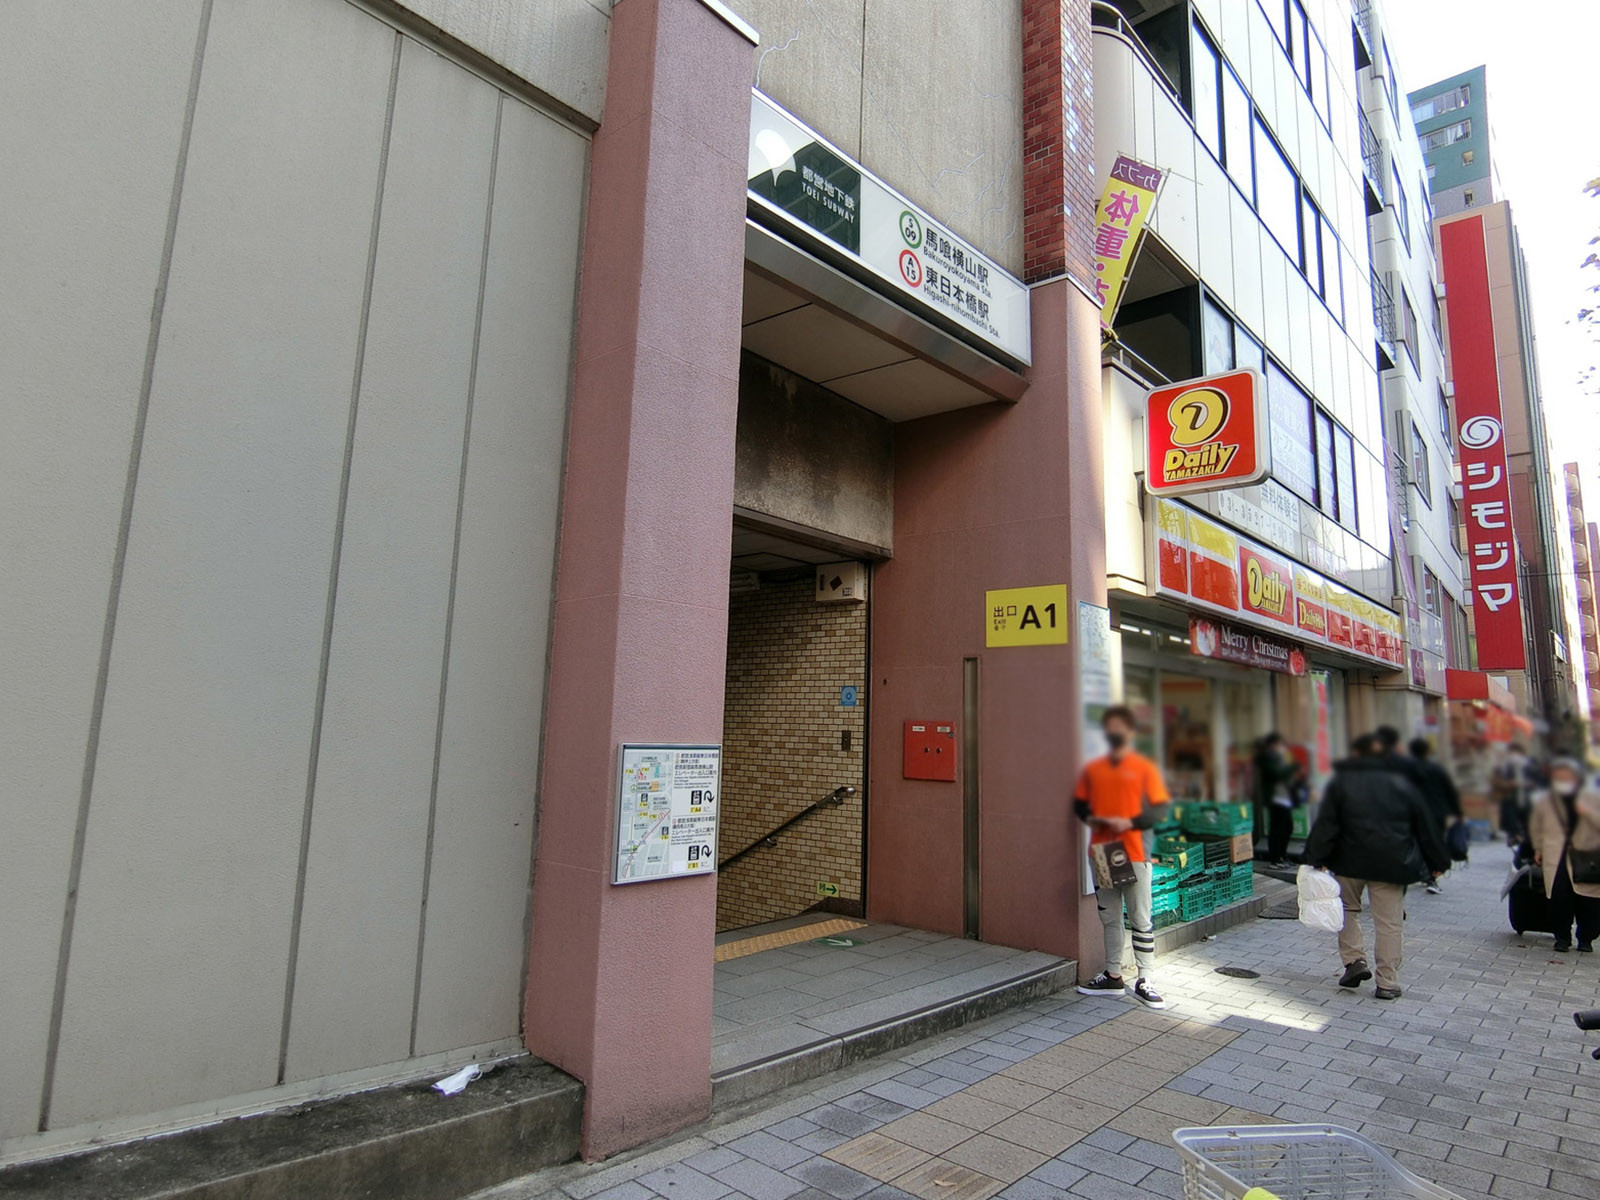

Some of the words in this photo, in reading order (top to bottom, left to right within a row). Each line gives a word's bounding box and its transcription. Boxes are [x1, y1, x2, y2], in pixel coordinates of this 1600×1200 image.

[802, 165, 855, 211] 都営地下鉄
[802, 181, 820, 201] TOEI
[823, 196, 854, 224] SUBWAY
[905, 227, 917, 241] 09
[908, 218, 914, 228] S
[906, 266, 917, 281] 15
[908, 257, 914, 268] A
[923, 245, 980, 292] Bakuroyokoyama
[981, 285, 992, 300] Sta.
[926, 227, 989, 286] 馬喰横山駅
[926, 265, 989, 321] 東日本橋駅
[923, 284, 988, 331] Higashi-nihombashi
[988, 323, 1001, 339] Sta.
[1165, 442, 1238, 475] Daily
[1165, 464, 1217, 481] YAMAZAKI
[1466, 462, 1512, 612] シモジマ
[1247, 556, 1287, 615] Daily
[993, 605, 1017, 618] 出口
[1019, 603, 1056, 630] A1
[1221, 624, 1249, 652] Merry
[1252, 634, 1288, 660] Christmas
